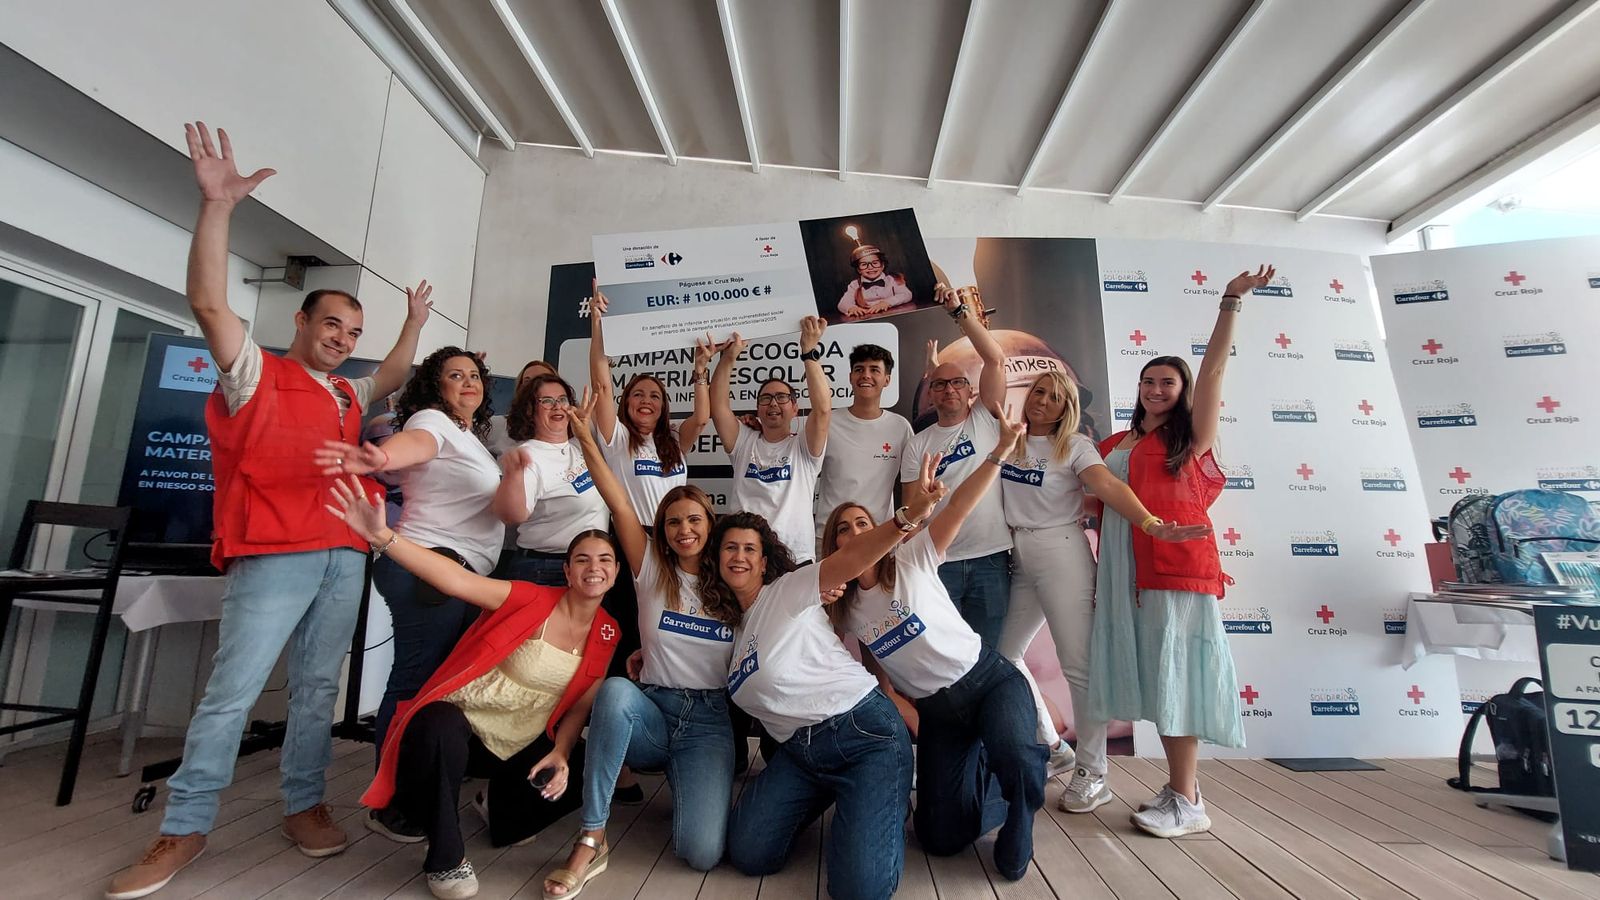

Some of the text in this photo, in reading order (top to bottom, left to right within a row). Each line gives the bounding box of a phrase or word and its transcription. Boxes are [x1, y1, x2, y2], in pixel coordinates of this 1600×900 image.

[679, 280, 706, 288] Páguese
[731, 276, 744, 284] Roja
[1104, 283, 1134, 291] Carrefour
[1254, 287, 1279, 295] Carrefour
[646, 285, 771, 307] EUR: # 100.000 € #
[1396, 294, 1430, 302] Carrefour
[736, 341, 844, 362] ECOGDA
[1336, 351, 1362, 359] Carrefour
[1288, 352, 1304, 360] Roja
[730, 365, 836, 384] ESCOLR
[172, 374, 217, 384] Cruz Roja
[1371, 419, 1387, 427] Roja
[1420, 418, 1456, 426] Carrefour
[1526, 416, 1579, 425] Cruz Roja
[148, 431, 211, 445] CAMPA
[145, 446, 212, 461] MATER
[151, 470, 189, 479] FAVOR
[191, 472, 206, 480] DE
[156, 481, 197, 491] RIESGO
[1309, 484, 1327, 492] Roja
[1540, 482, 1582, 490] Carrefour
[1466, 487, 1489, 495] Roja
[1236, 550, 1254, 558] Roja
[662, 616, 711, 633] Carrefour
[1329, 628, 1347, 636] Roja
[1253, 709, 1272, 718] Roja
[1420, 709, 1439, 717] Roja
